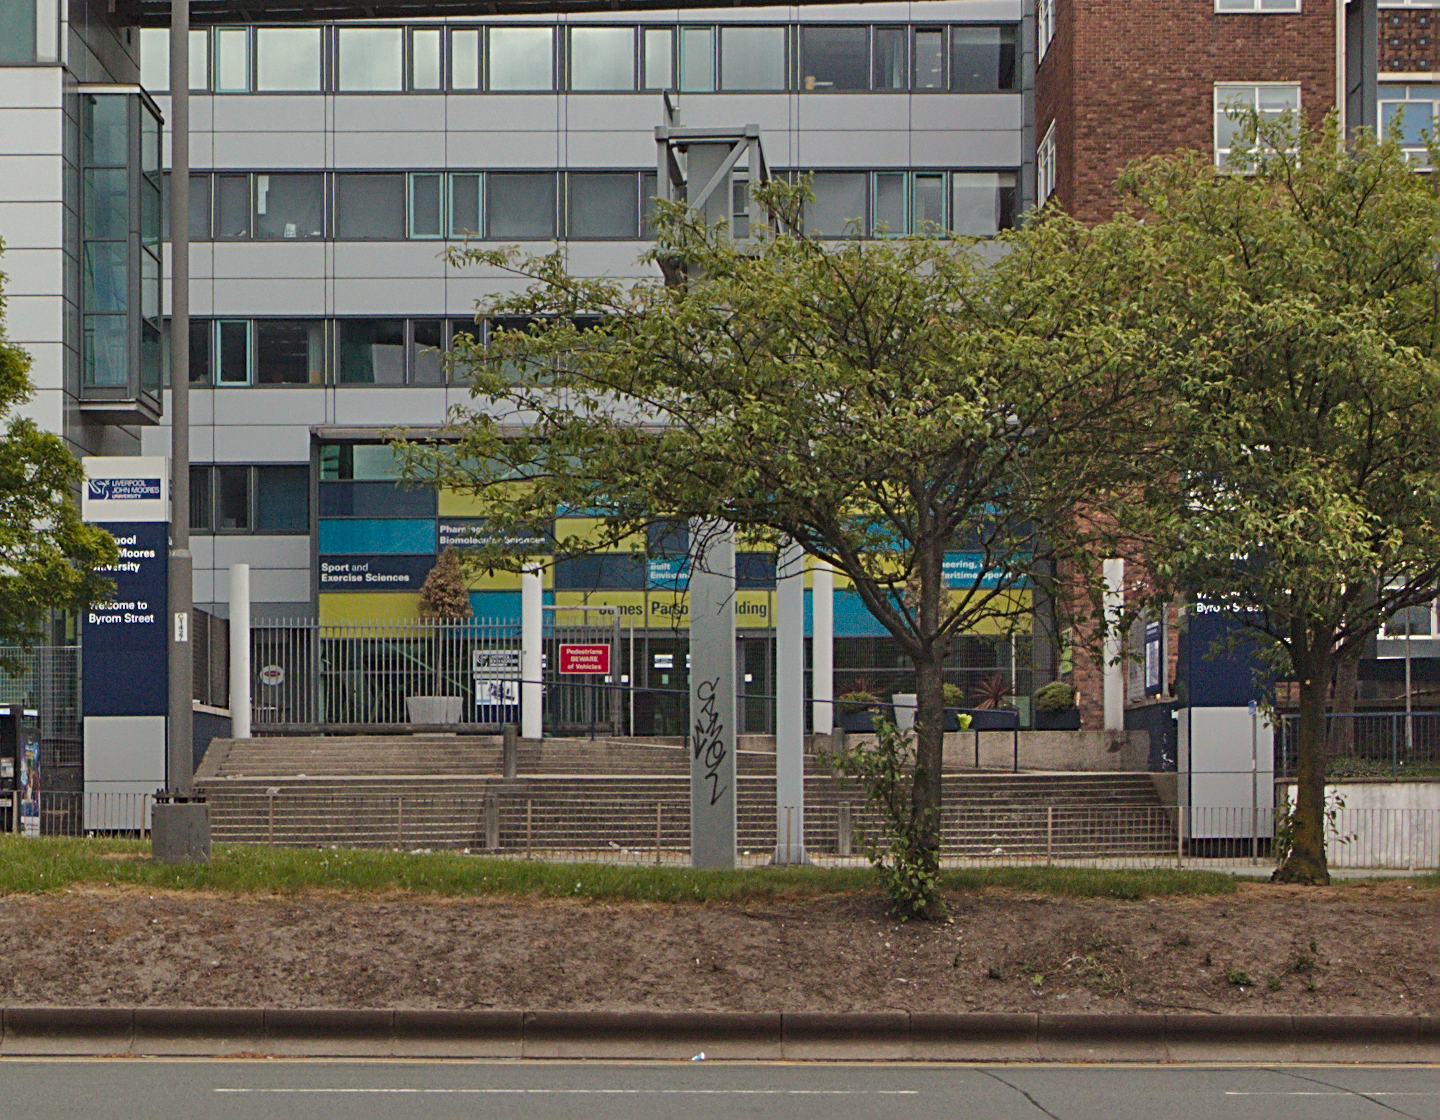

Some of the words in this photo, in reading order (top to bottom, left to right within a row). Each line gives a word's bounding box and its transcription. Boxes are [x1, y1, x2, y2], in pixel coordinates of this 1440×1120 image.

[111, 486, 130, 494] JOHN
[131, 486, 160, 494] MOORES
[321, 563, 350, 573] Sport
[351, 563, 369, 572] and
[650, 562, 671, 571] Built
[321, 574, 363, 582] Exercise
[365, 574, 410, 582] Sciences
[650, 571, 690, 579] Environ
[137, 601, 148, 610] to
[651, 602, 689, 615] Parso
[735, 602, 767, 618] lding
[88, 613, 122, 625] Byrom
[124, 613, 155, 623] Street
